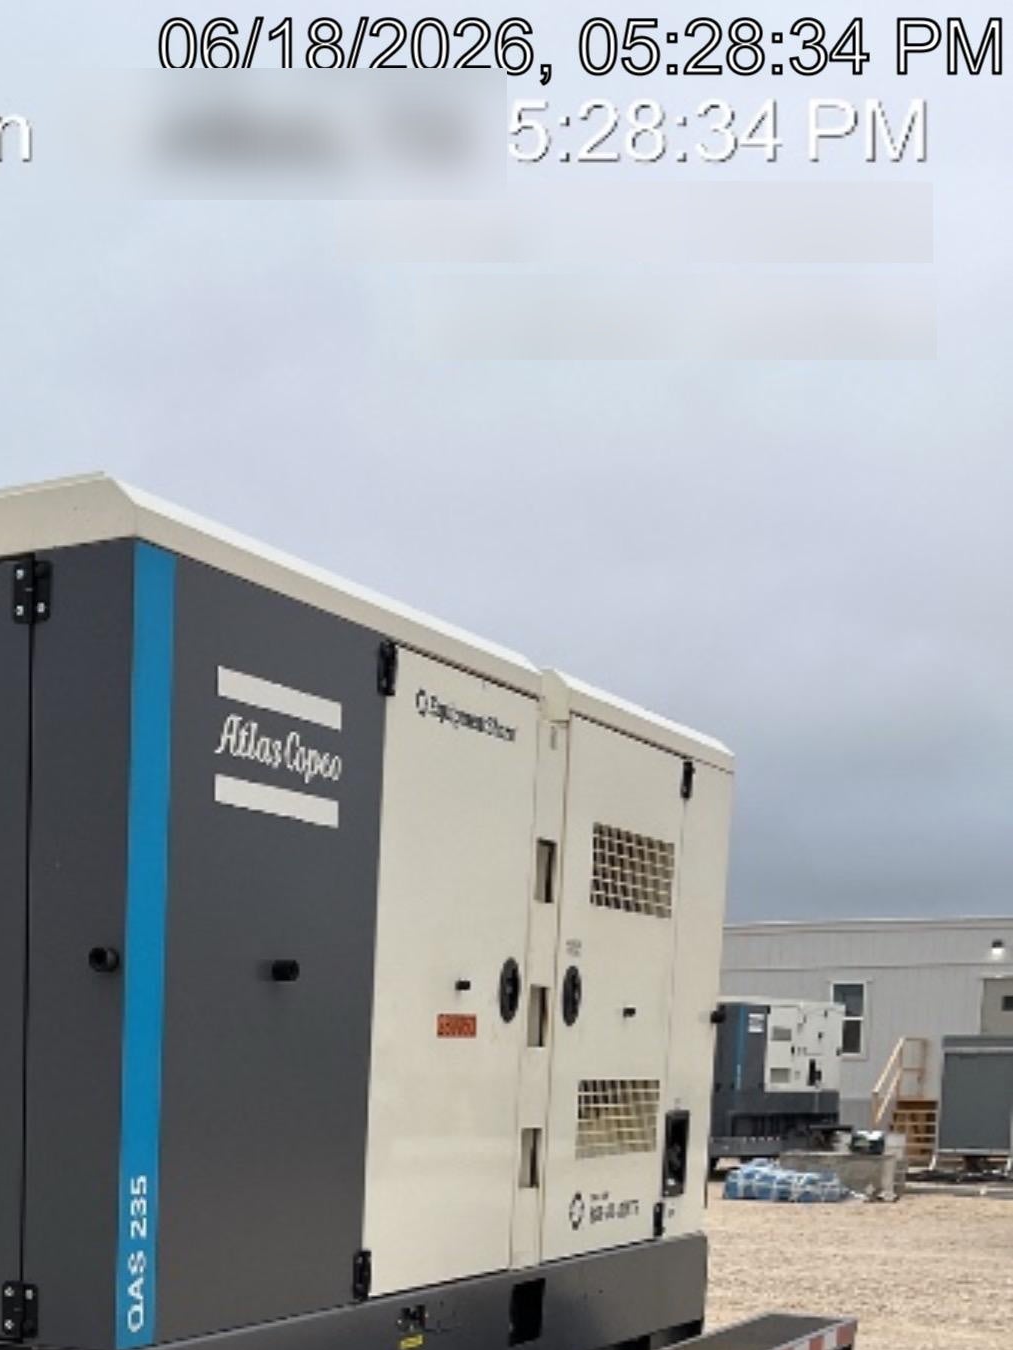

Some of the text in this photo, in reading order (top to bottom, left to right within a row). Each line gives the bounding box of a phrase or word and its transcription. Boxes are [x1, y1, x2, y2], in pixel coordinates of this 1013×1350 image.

[213, 713, 342, 784] Atlas Copco
[127, 1175, 148, 1333] QAS 235
